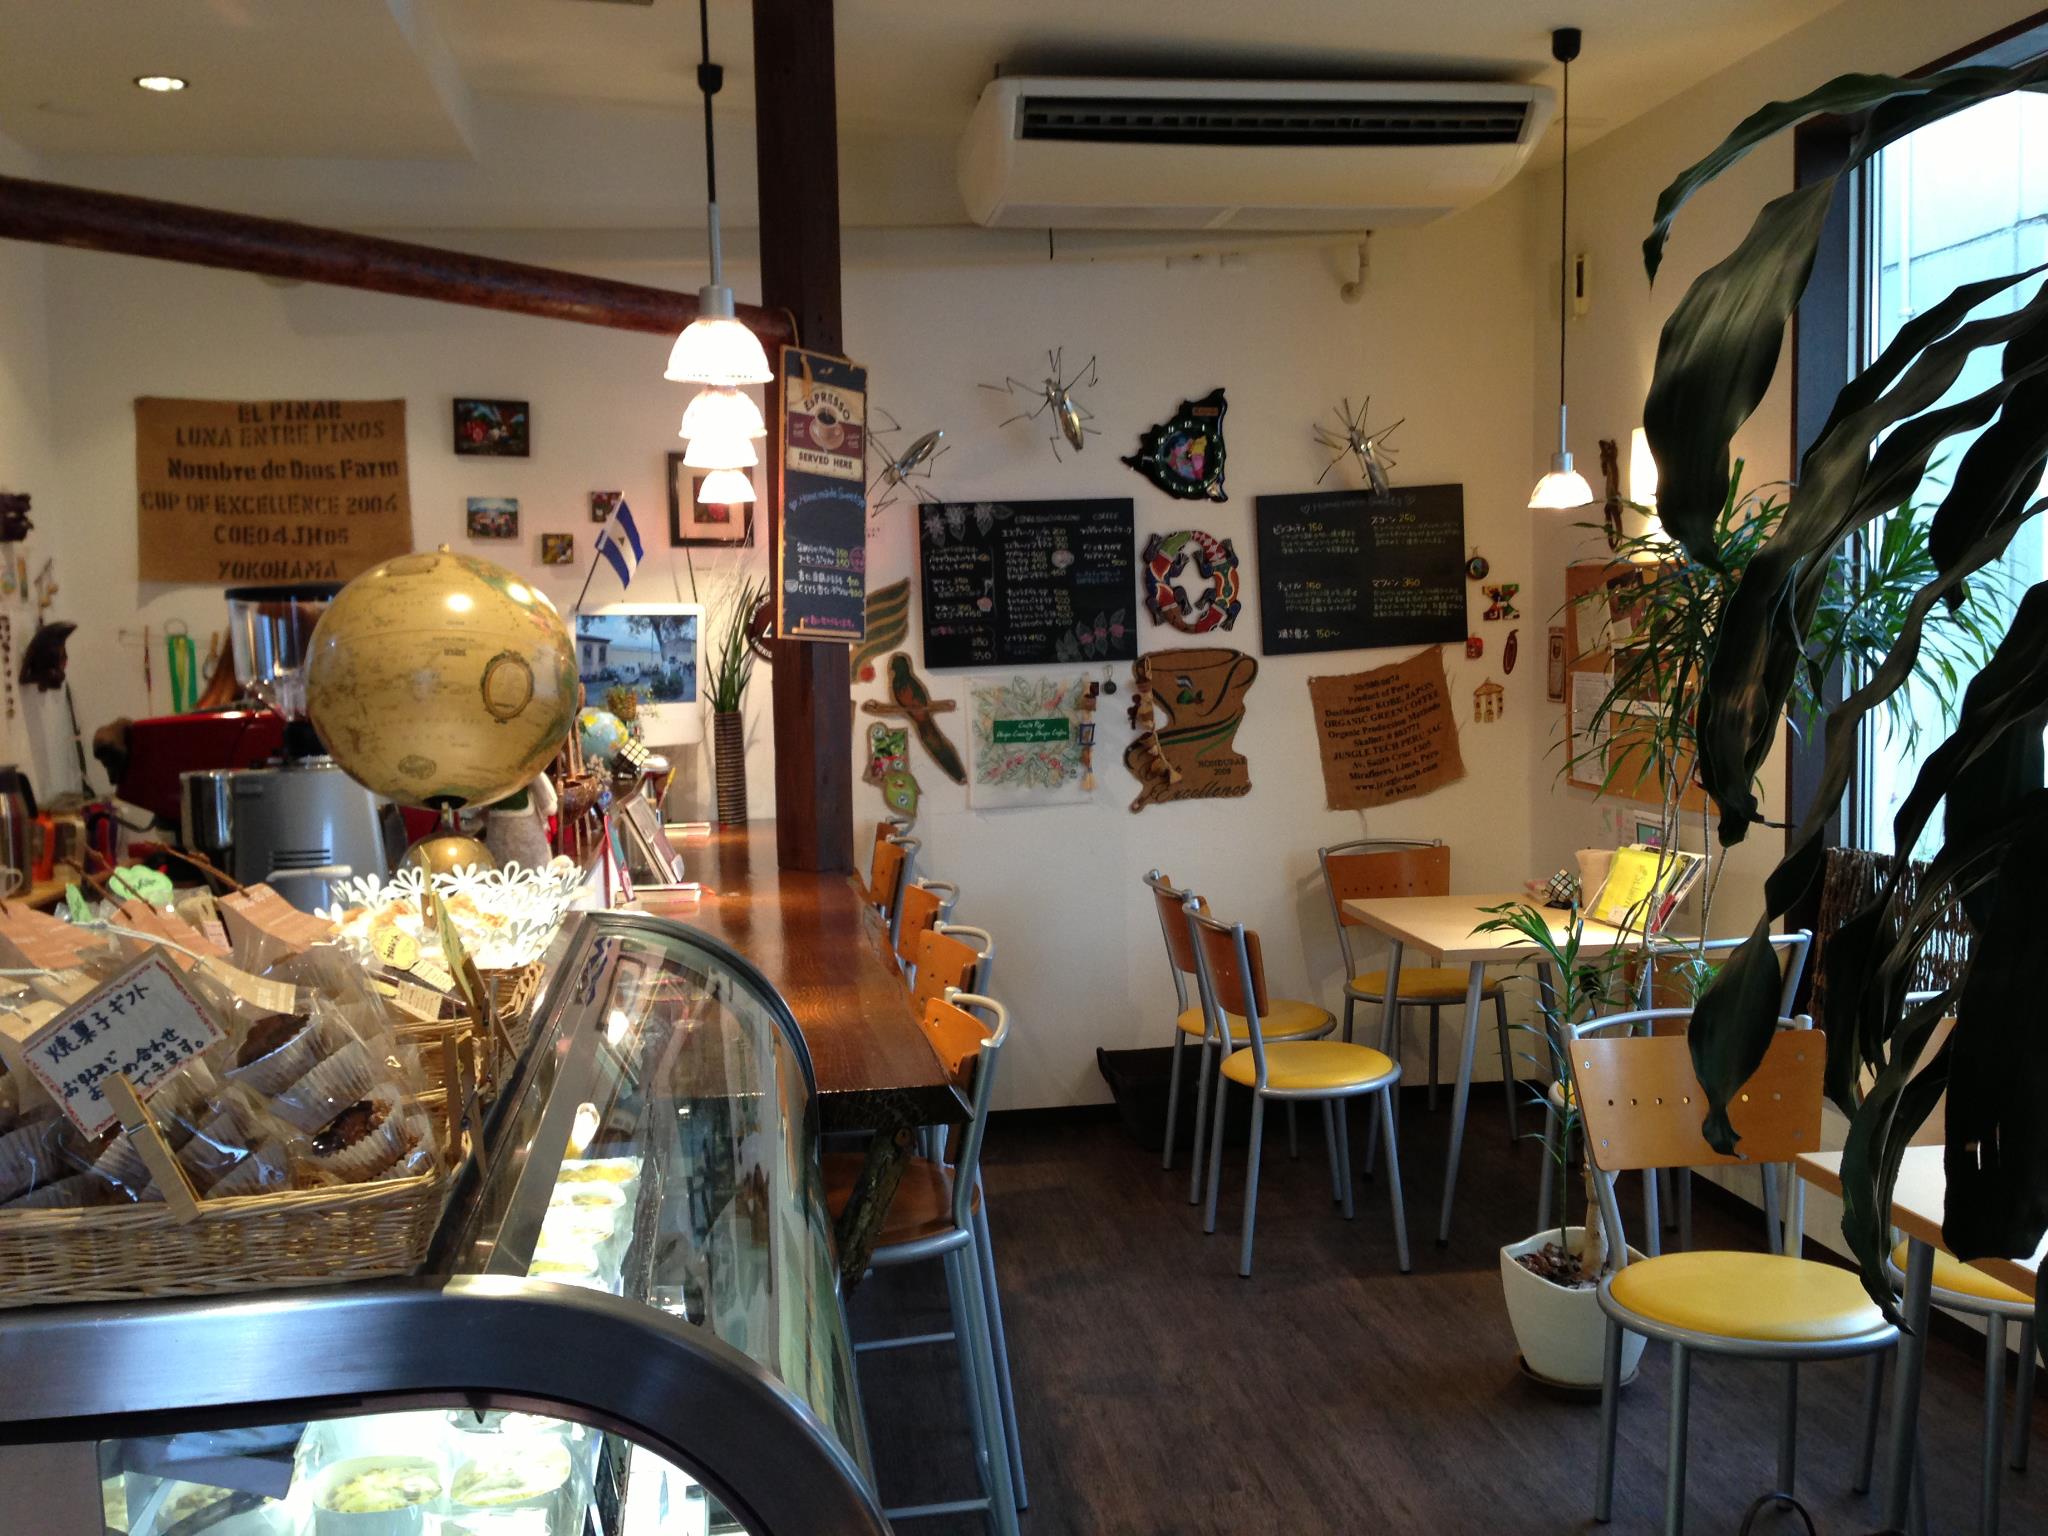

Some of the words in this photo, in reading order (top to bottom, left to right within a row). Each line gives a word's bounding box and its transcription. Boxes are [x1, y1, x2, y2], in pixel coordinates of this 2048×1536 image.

[237, 402, 263, 424] EL
[270, 401, 342, 421] PINAR
[804, 391, 851, 421] ESPRESSO
[175, 427, 232, 449] LUNA
[240, 424, 309, 449] ENTRE
[315, 420, 385, 443] PINOS
[168, 458, 256, 482] Nombre
[261, 459, 288, 481] de
[290, 460, 336, 480] Dios
[340, 458, 400, 479] Farm
[798, 451, 830, 466] SERVED
[833, 458, 853, 470] HERE
[141, 492, 180, 512] CUP
[186, 494, 210, 514] OF
[214, 494, 340, 516] EXCELLENCE
[217, 559, 338, 581] YOKOHAMA
[1348, 689, 1381, 704] Product
[1391, 683, 1410, 694] Peru
[1324, 715, 1369, 728] ORGANIC
[1370, 707, 1403, 722] GREEN
[1328, 726, 1361, 739] Organic
[1333, 748, 1373, 761] JUNGLE
[45, 984, 150, 1064] 焼菓子ギフト
[63, 1050, 118, 1098] お好みで
